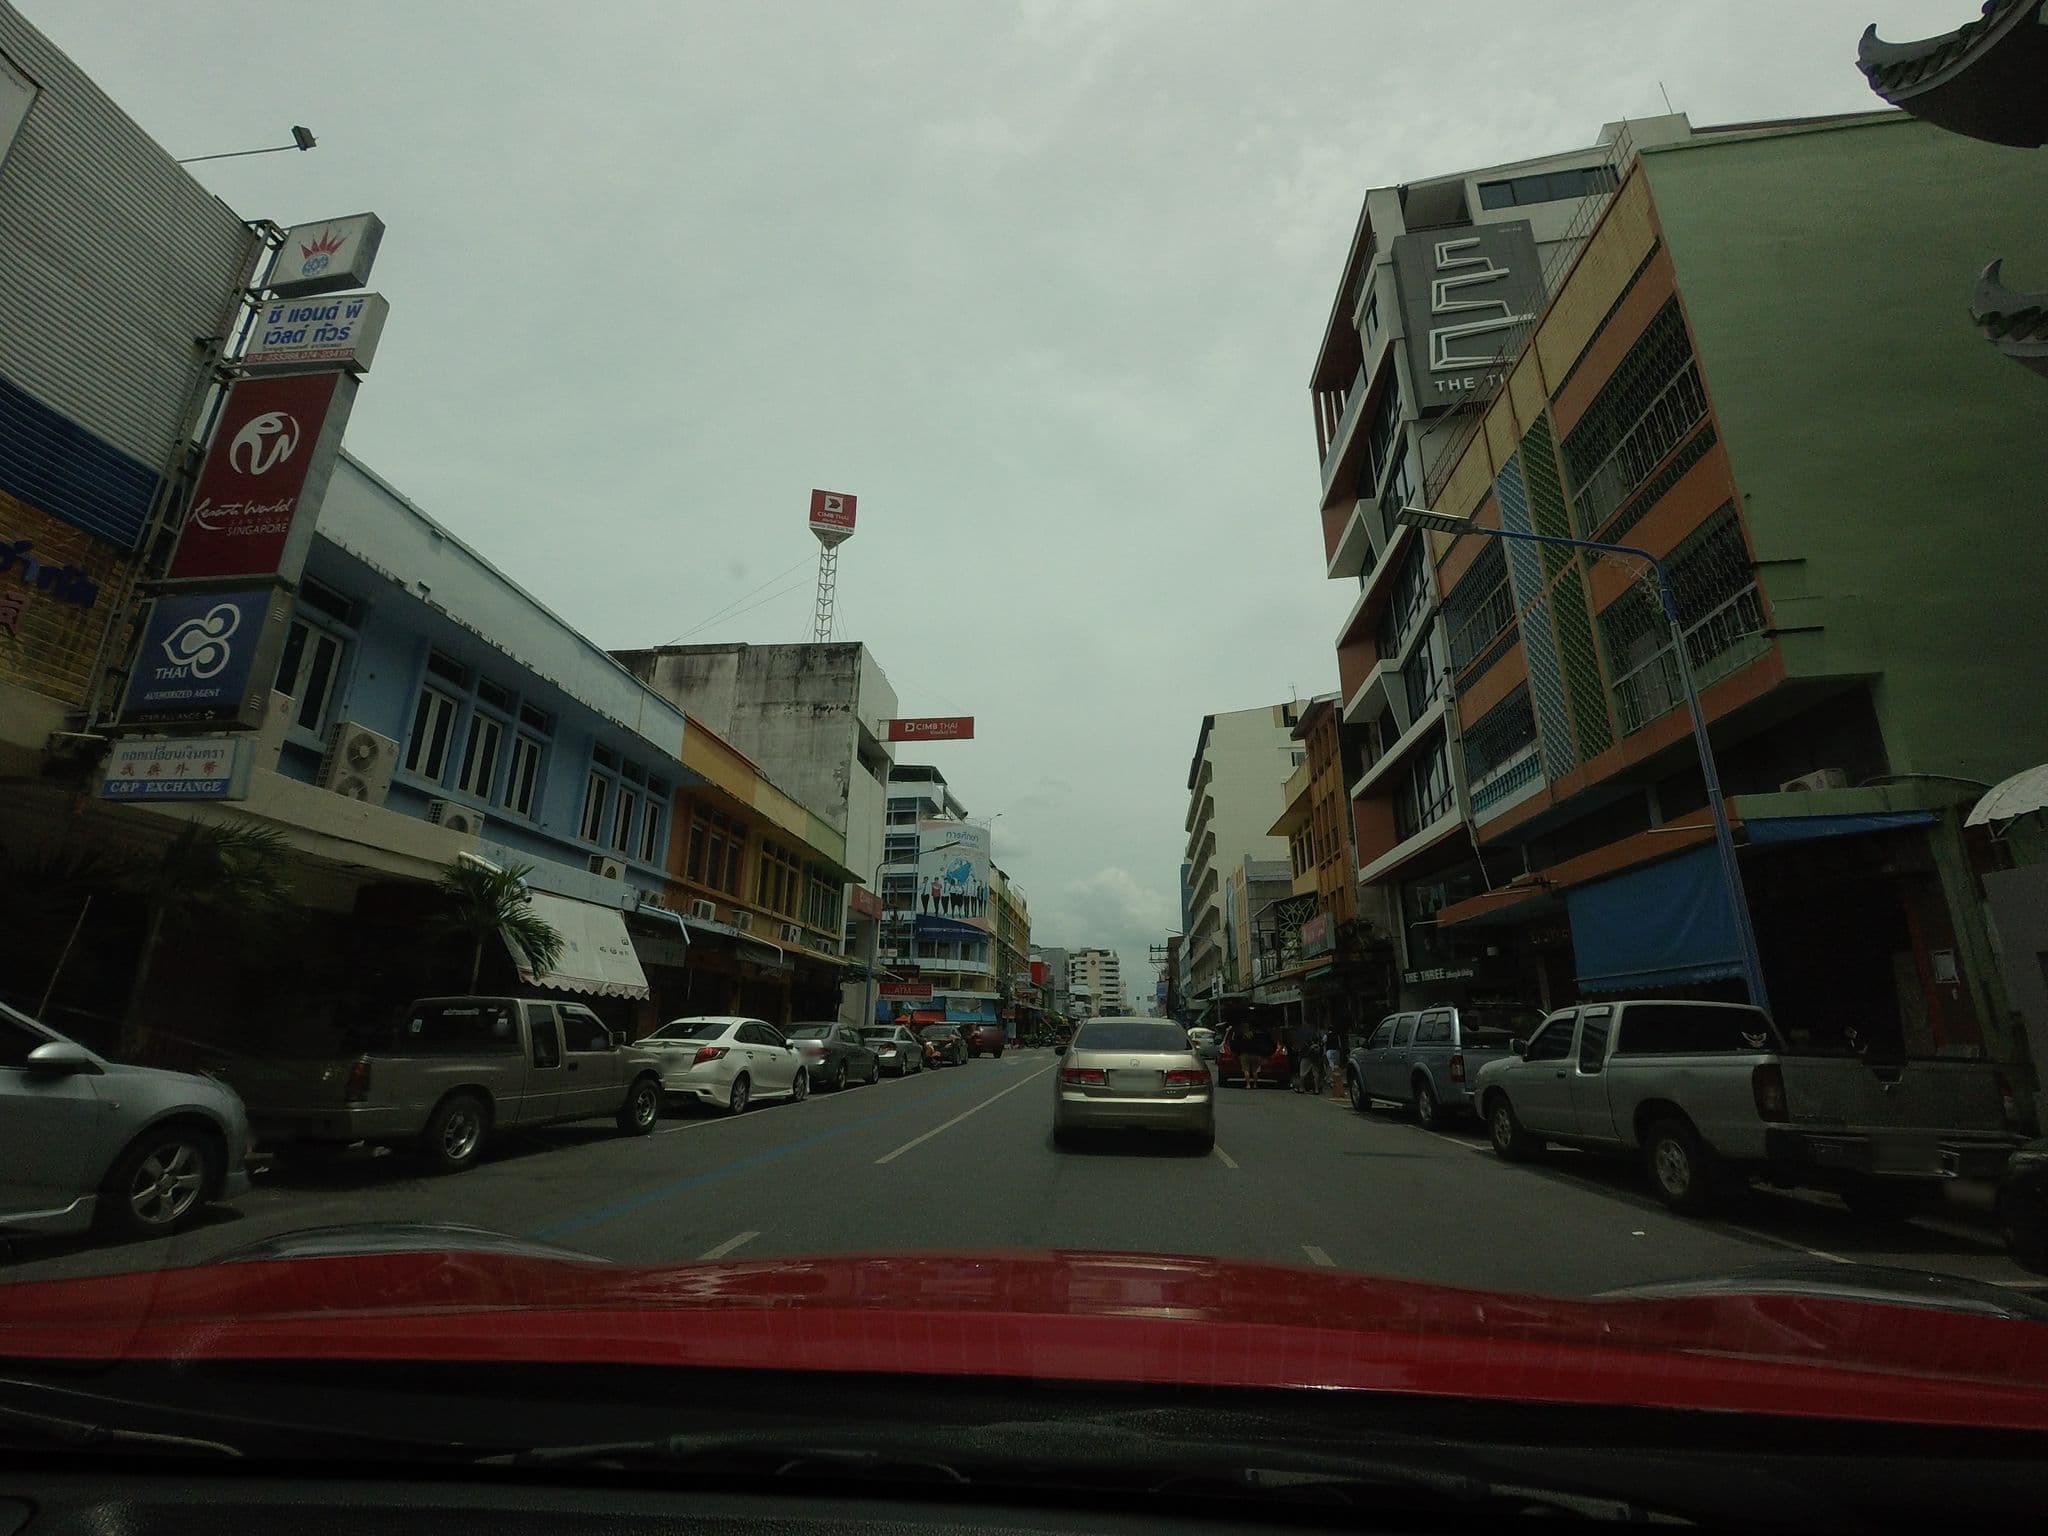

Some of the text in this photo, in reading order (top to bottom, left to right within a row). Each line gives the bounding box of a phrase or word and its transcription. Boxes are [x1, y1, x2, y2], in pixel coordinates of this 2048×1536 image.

[287, 300, 342, 323] แอนด์
[346, 298, 364, 319] พี
[263, 321, 354, 345] เวิลด์ ทัวร์
[1434, 376, 1476, 393] THE
[243, 496, 296, 515] World
[817, 511, 835, 519] CIMB
[226, 522, 289, 537] SINGAPORE
[155, 667, 189, 679] THAI
[193, 688, 220, 698] AGENT
[916, 722, 958, 731] CIMB THAI
[110, 780, 222, 793] C&P EXCHANGE
[1404, 971, 1419, 984] THE
[1420, 967, 1446, 982] THREE
